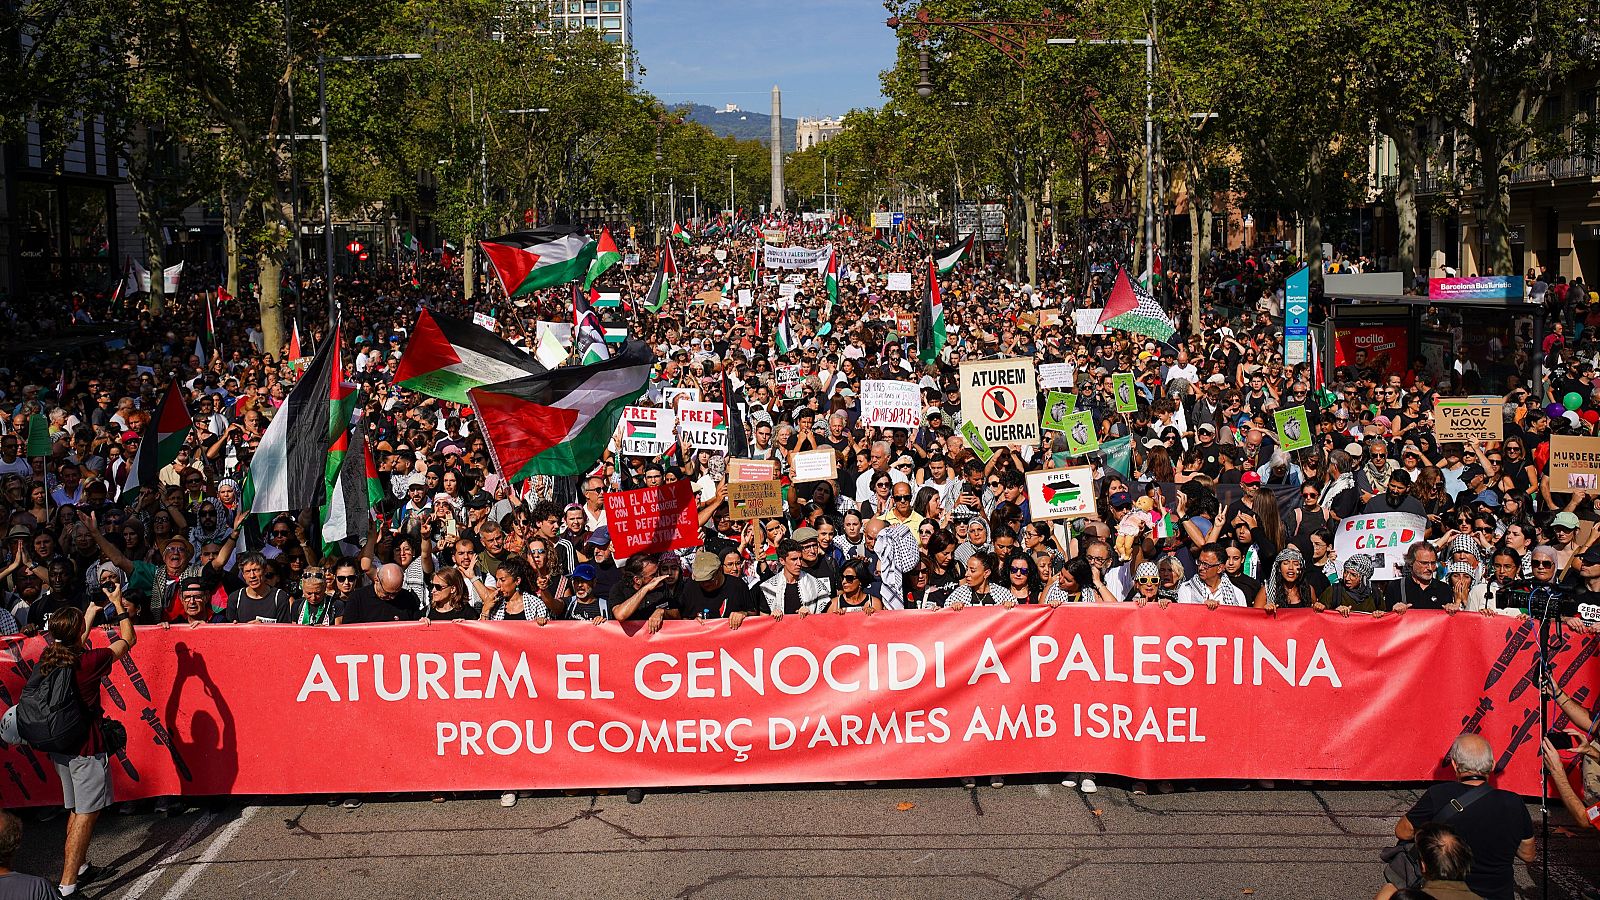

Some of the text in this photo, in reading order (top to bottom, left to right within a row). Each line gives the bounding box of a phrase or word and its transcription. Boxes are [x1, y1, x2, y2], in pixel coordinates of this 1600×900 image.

[1354, 333, 1384, 344] nocilla
[971, 368, 1026, 387] ATUREM
[623, 407, 657, 420] FREE
[681, 410, 712, 423] FREE
[1442, 407, 1491, 418] PEACE
[1450, 418, 1487, 427] NOW
[984, 423, 1036, 442] GUERRA!
[622, 439, 672, 454] ALESTINE
[1570, 461, 1589, 469] 355
[1047, 473, 1071, 481] FREE
[608, 486, 677, 510] CON EL ALMA Y
[615, 499, 678, 519] CON LA SANGRE
[1049, 505, 1078, 514] PALESTINE
[614, 507, 692, 533] TE DEFENDERÉ,
[1345, 518, 1386, 531] FREE
[626, 528, 683, 547] PALESTINA
[1355, 531, 1398, 550] GAZA
[297, 633, 1342, 701] ATUREM EL GENOCIDI A PALESTINA
[437, 719, 552, 755] PROU
[568, 717, 752, 762] COMERÇ
[963, 704, 1056, 741] AMB
[1074, 703, 1205, 742] ISRAEL
